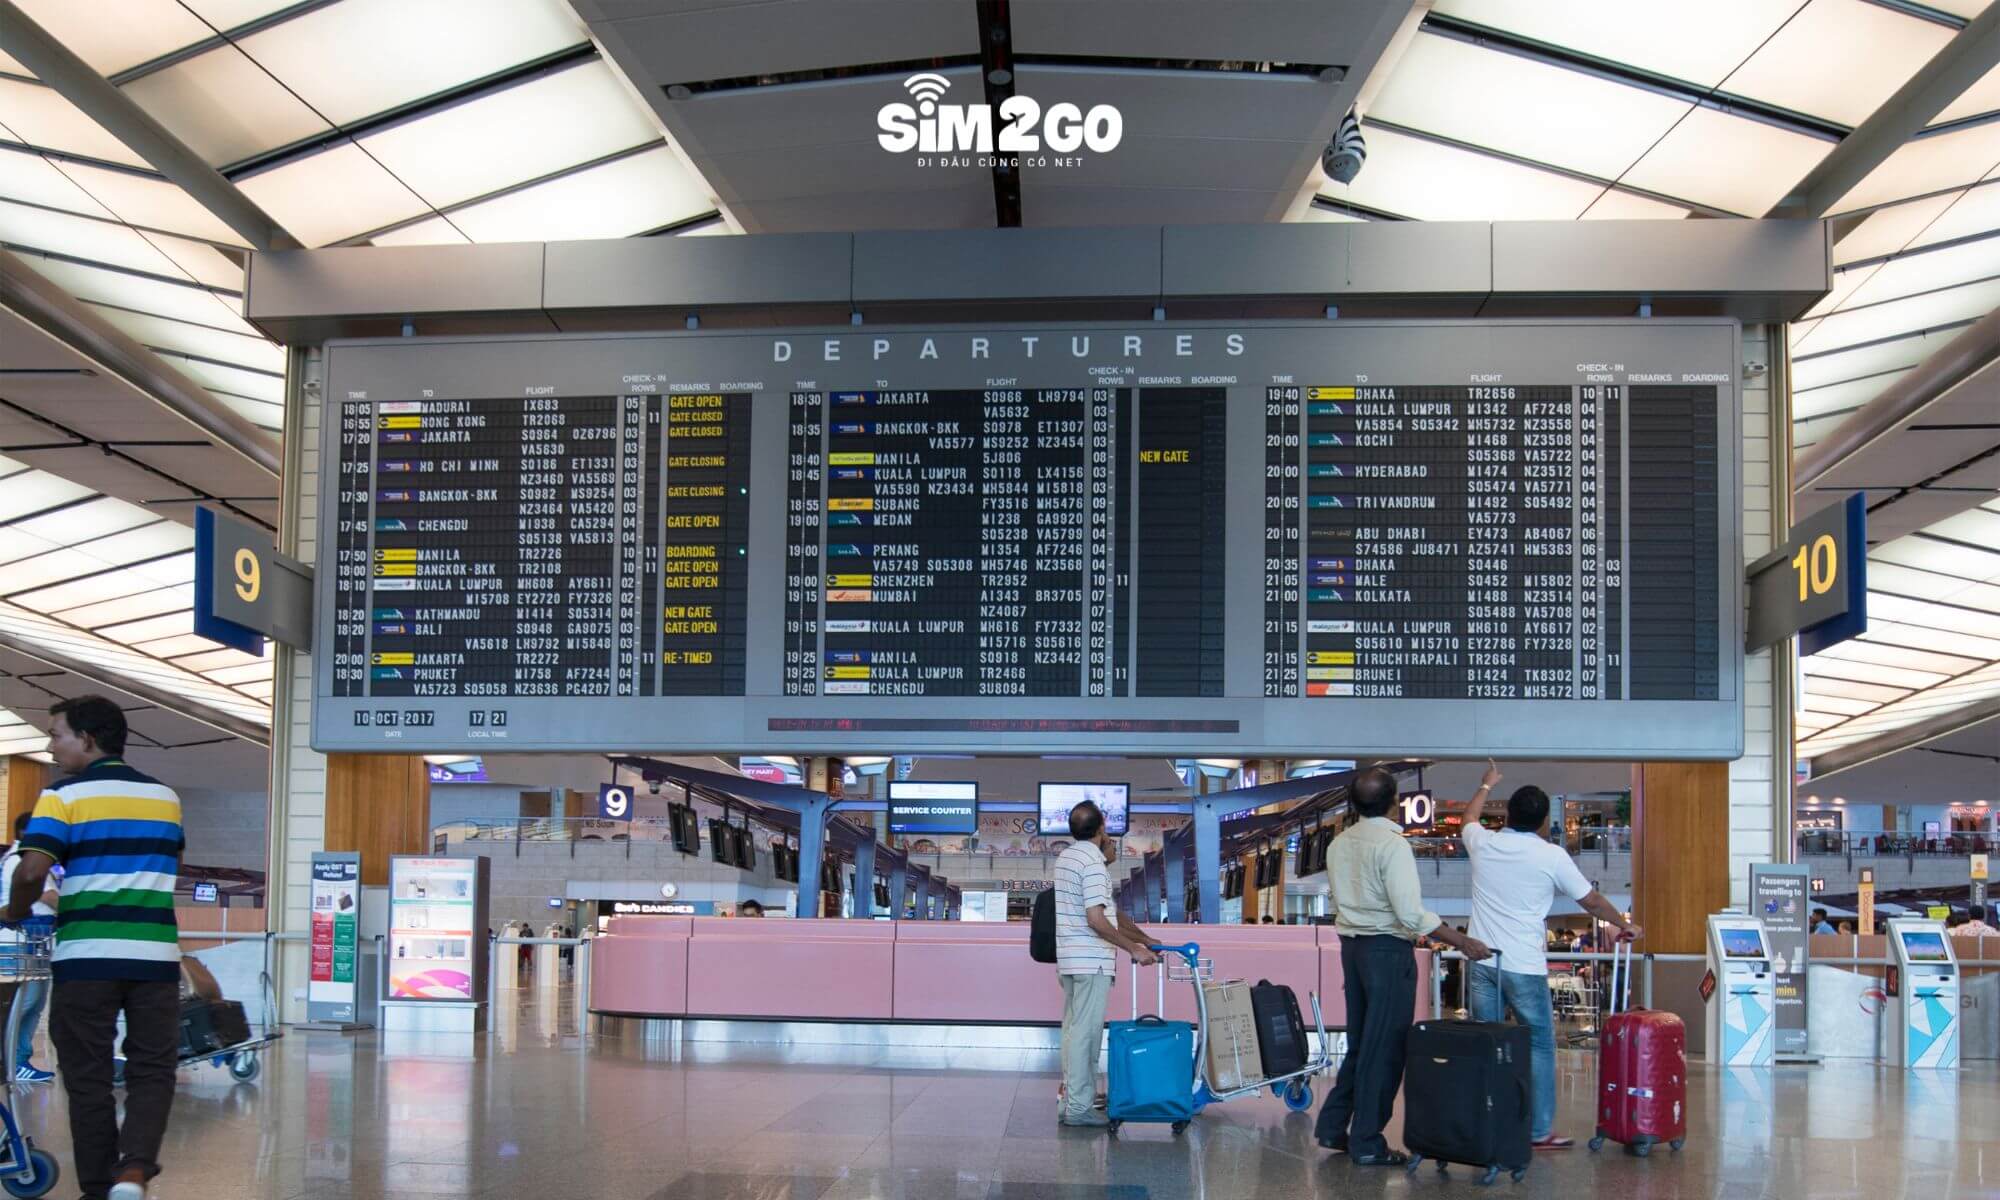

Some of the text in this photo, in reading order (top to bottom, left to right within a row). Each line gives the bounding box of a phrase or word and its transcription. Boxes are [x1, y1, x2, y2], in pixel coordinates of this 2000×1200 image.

[774, 335, 1245, 363] DEPARTURES
[876, 393, 928, 403] JAKARTA
[1354, 389, 1394, 399] DHAKA
[671, 395, 721, 407] GATE OPEN
[420, 402, 469, 413] MADURAI
[1356, 404, 1450, 415] KUALA LUMPUR
[420, 416, 485, 427] HONG KONG
[669, 412, 722, 421] GATE CLOSED
[421, 431, 470, 442] JAKARTA
[668, 427, 722, 436] GATE CLOSED
[1356, 435, 1392, 446] KOCHI
[668, 457, 724, 466] GATE CLOSING
[874, 454, 920, 464] MANILA
[1139, 451, 1188, 462] NEW GATE
[420, 460, 498, 472] HO CHI MINH
[1356, 466, 1427, 477] HYDERABAD
[875, 468, 966, 479] KUALA LUMPUR
[667, 487, 724, 496] GATE CLOSING
[873, 499, 919, 510] SUBANG
[1357, 497, 1435, 508] TRIVANDRUM
[419, 520, 468, 530] CHENGDU
[666, 516, 719, 527] GATE OPEN
[874, 515, 911, 525] MEDAN
[1356, 528, 1378, 539] ABU
[1388, 528, 1424, 539] DHABI
[416, 550, 459, 560] MANILA
[665, 547, 714, 557] BOARDING
[874, 545, 918, 555] PENANG
[667, 562, 718, 572] GATE OPEN
[1356, 560, 1394, 570] DHAKA
[1792, 534, 1837, 602] 10
[234, 548, 260, 602] 9
[872, 575, 933, 586] SHENZHEN
[1356, 575, 1386, 586] MALE
[414, 579, 502, 590] KUALA LUMPUR
[664, 577, 717, 587] GATE OPEN
[871, 591, 915, 601] MUMBAI
[1356, 591, 1410, 601] KOLKATA
[416, 609, 480, 619] KATHMANDU
[666, 607, 711, 617] NEW GATE
[415, 624, 441, 635] BALI
[664, 622, 716, 633] GATE OPEN
[871, 622, 909, 632] KUALA
[919, 621, 963, 632] LUMPUR
[1354, 622, 1394, 633] KUALA
[1404, 622, 1450, 633] LUMPUR
[413, 654, 464, 664] JAKARTA
[871, 652, 916, 663] MANILA
[414, 669, 456, 679] PHUKET
[870, 668, 963, 678] KUALA LUMPUR
[1354, 669, 1400, 680] BRUNEI
[870, 683, 924, 694] CHENGDU
[1354, 685, 1402, 696] SUBANG
[605, 789, 627, 816] 9
[893, 806, 972, 814] SERVICE COUNTER
[1400, 794, 1431, 825] 10
[1760, 877, 1800, 887] Passengers
[1812, 880, 1824, 890] 11
[1759, 888, 1793, 897] travelling
